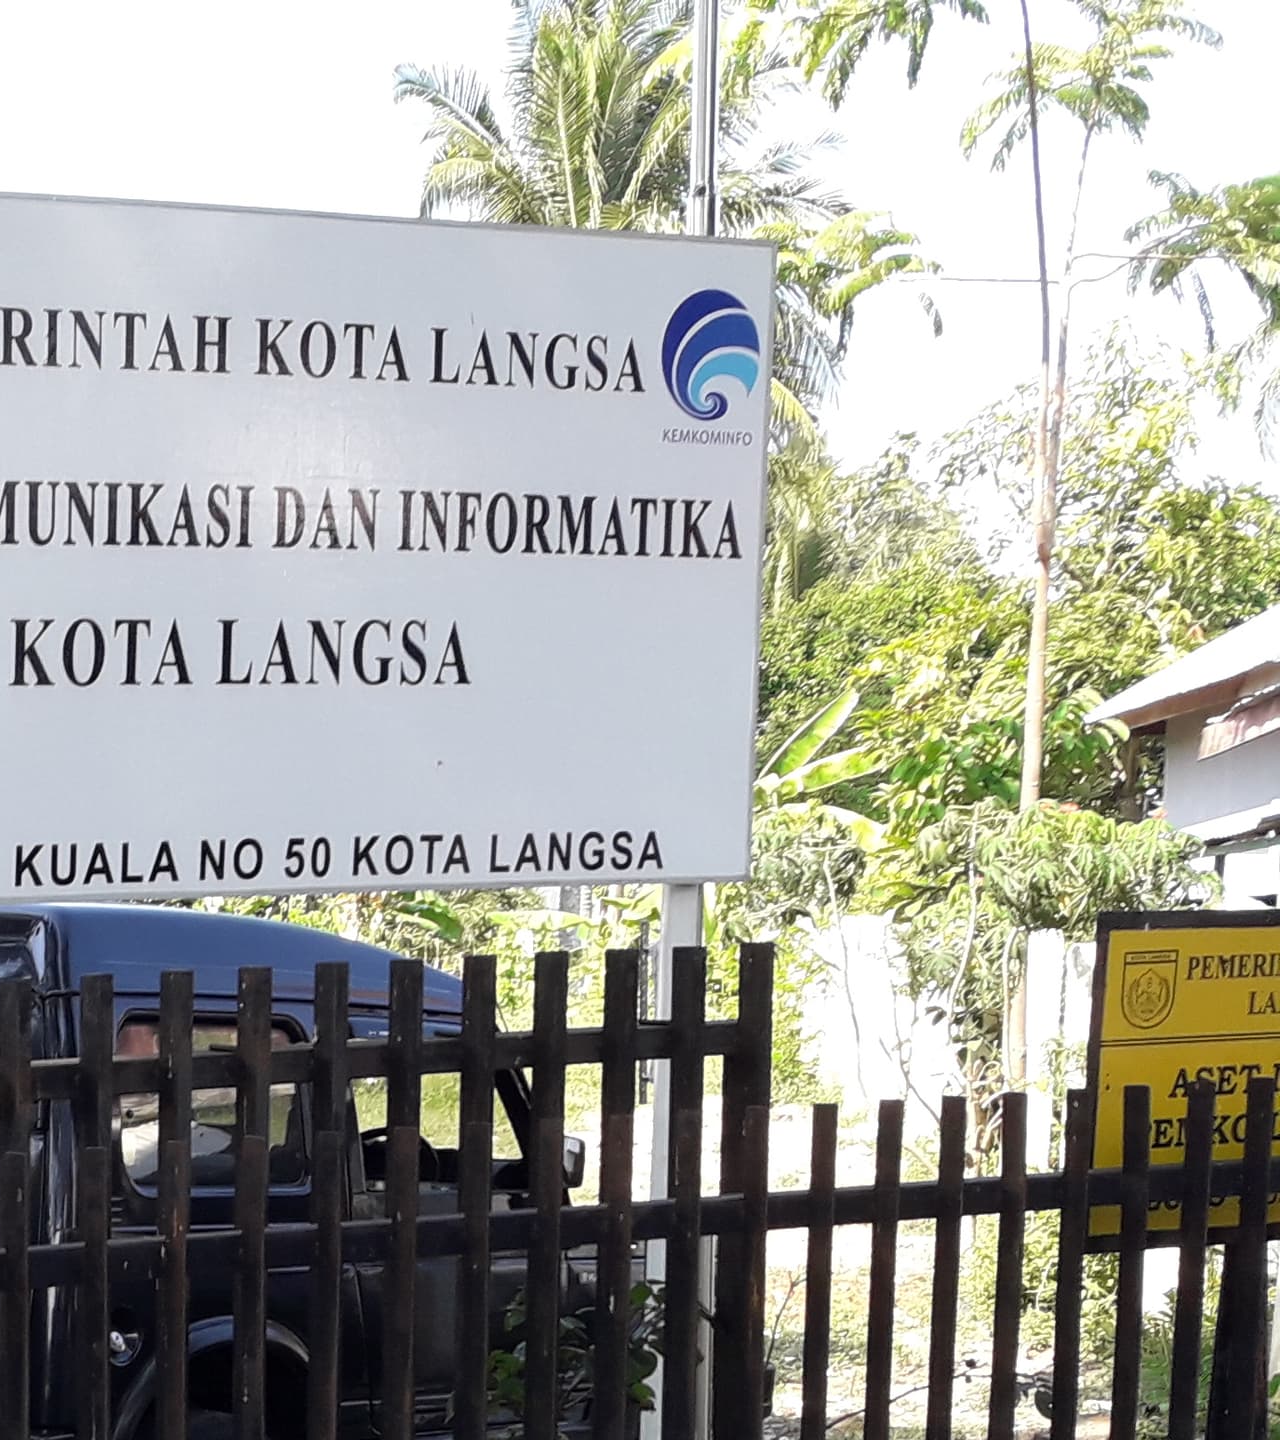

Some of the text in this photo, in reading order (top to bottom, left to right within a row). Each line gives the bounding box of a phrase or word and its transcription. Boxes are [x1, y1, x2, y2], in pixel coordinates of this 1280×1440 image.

[255, 317, 411, 383] KOTA
[429, 327, 646, 394] LANGSA
[661, 428, 753, 446] KEMKOMINFO
[272, 488, 380, 551] DAN
[395, 489, 743, 560] INFORMATIKA
[8, 617, 472, 688] KOTA LANGSA
[13, 839, 180, 888] KUALA
[198, 837, 265, 882] NO
[283, 835, 333, 880] 50
[351, 833, 471, 878] KOTA
[488, 829, 664, 875] LANGSA
[1186, 952, 1280, 981] PEMERI
